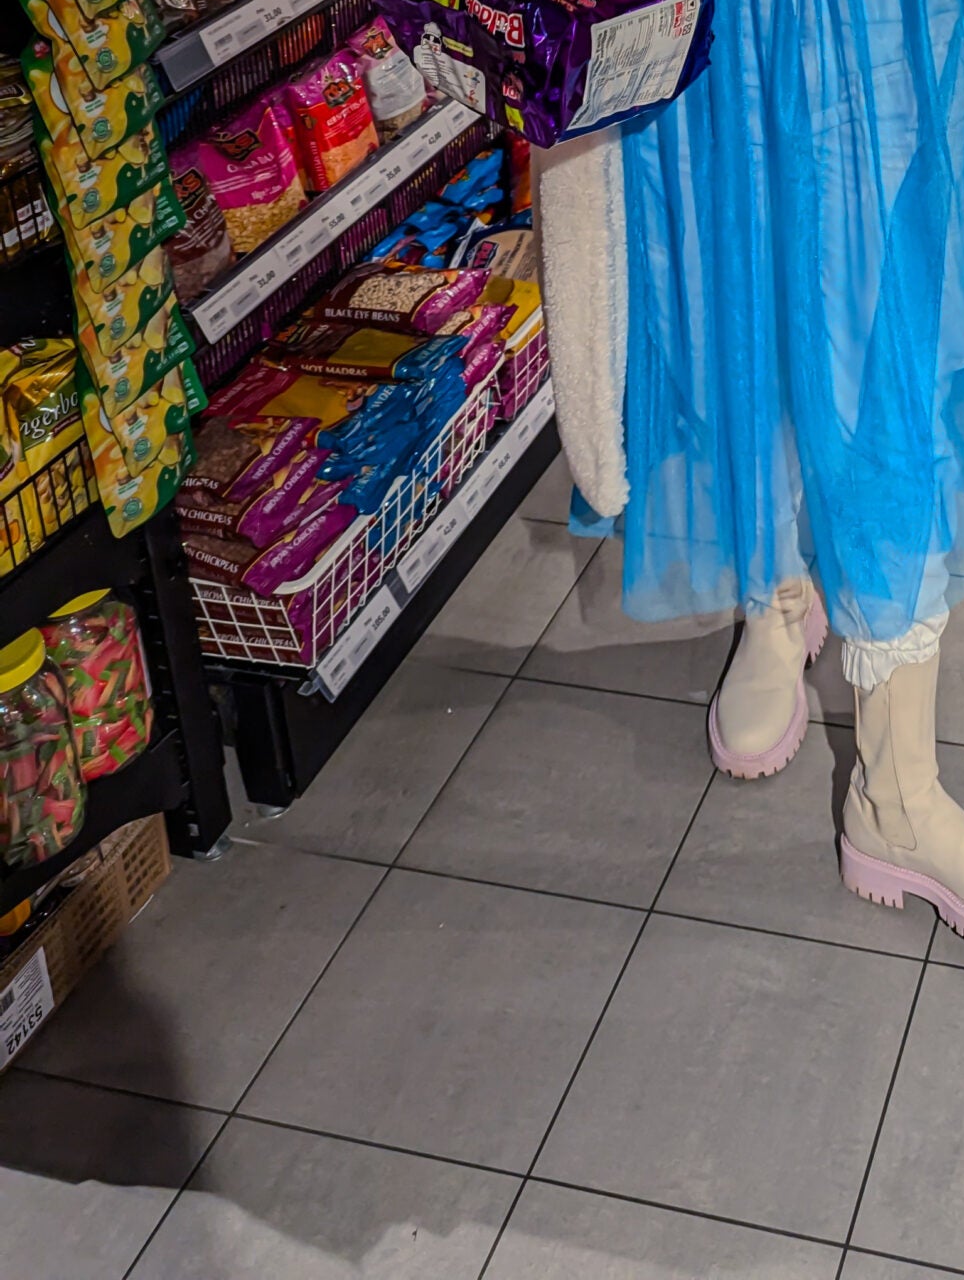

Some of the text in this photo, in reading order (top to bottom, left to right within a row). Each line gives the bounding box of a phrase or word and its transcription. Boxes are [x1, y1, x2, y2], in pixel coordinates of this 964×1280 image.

[325, 308, 353, 319] BLACK
[372, 311, 400, 322] BEANS
[301, 364, 368, 377] HOT MADRAS
[20, 391, 78, 439] ngerbo
[189, 510, 233, 526] CHICKPEAS
[195, 552, 239, 573] CHICKPEAS
[6, 1005, 43, 1056] 53142
